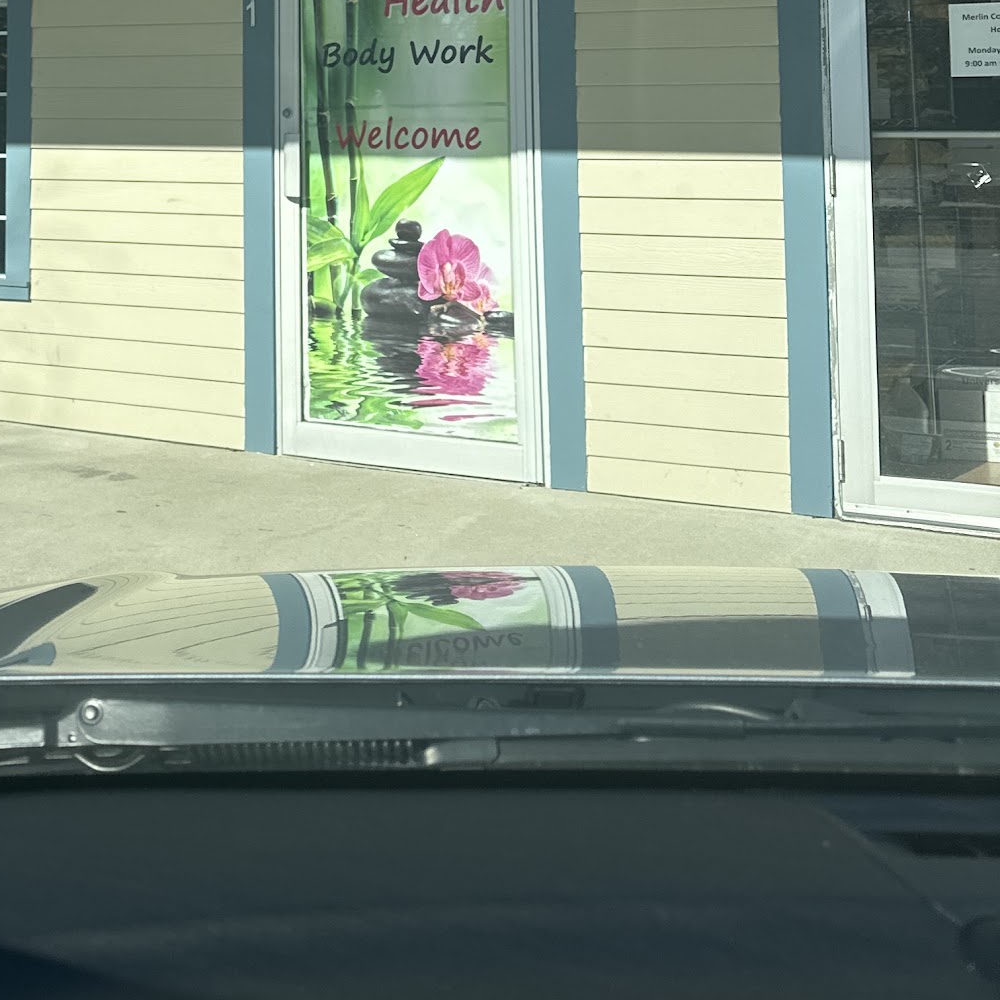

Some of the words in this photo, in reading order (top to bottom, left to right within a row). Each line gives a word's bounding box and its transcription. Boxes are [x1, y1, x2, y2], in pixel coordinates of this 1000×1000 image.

[246, 0, 256, 27] 1
[962, 13, 989, 21] Merlin
[321, 38, 395, 74] Body
[409, 35, 494, 65] Work
[968, 46, 1000, 55] Monday
[964, 60, 983, 68] 9:00
[336, 116, 482, 150] Welcome
